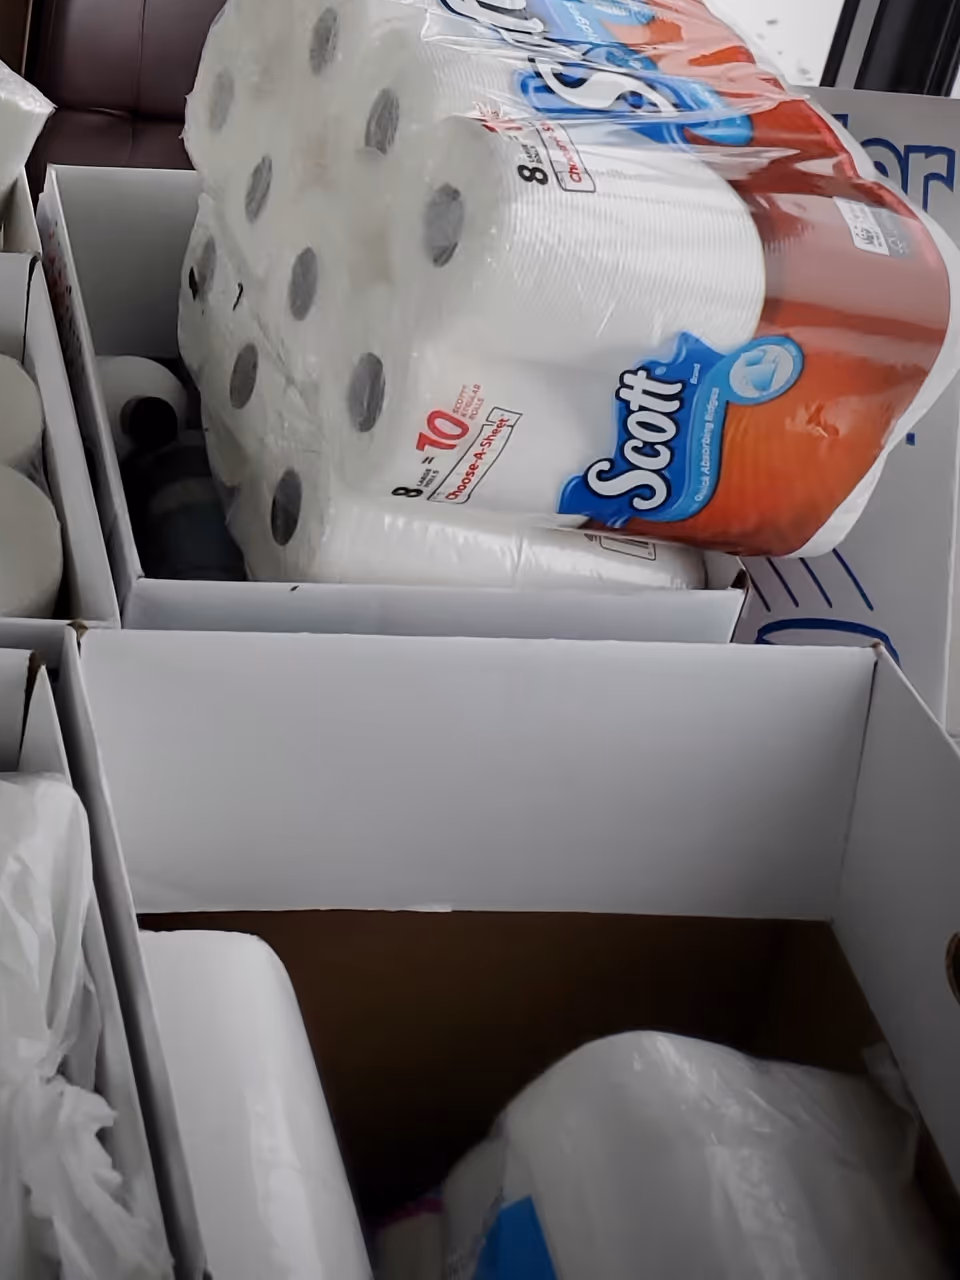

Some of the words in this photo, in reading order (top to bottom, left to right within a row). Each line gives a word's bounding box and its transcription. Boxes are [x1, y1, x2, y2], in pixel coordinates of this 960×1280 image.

[517, 164, 549, 186] 8
[391, 486, 424, 498] 8
[415, 410, 470, 452] 10
[445, 416, 510, 501] Choose-A-Sheet
[586, 366, 685, 512] Scott
